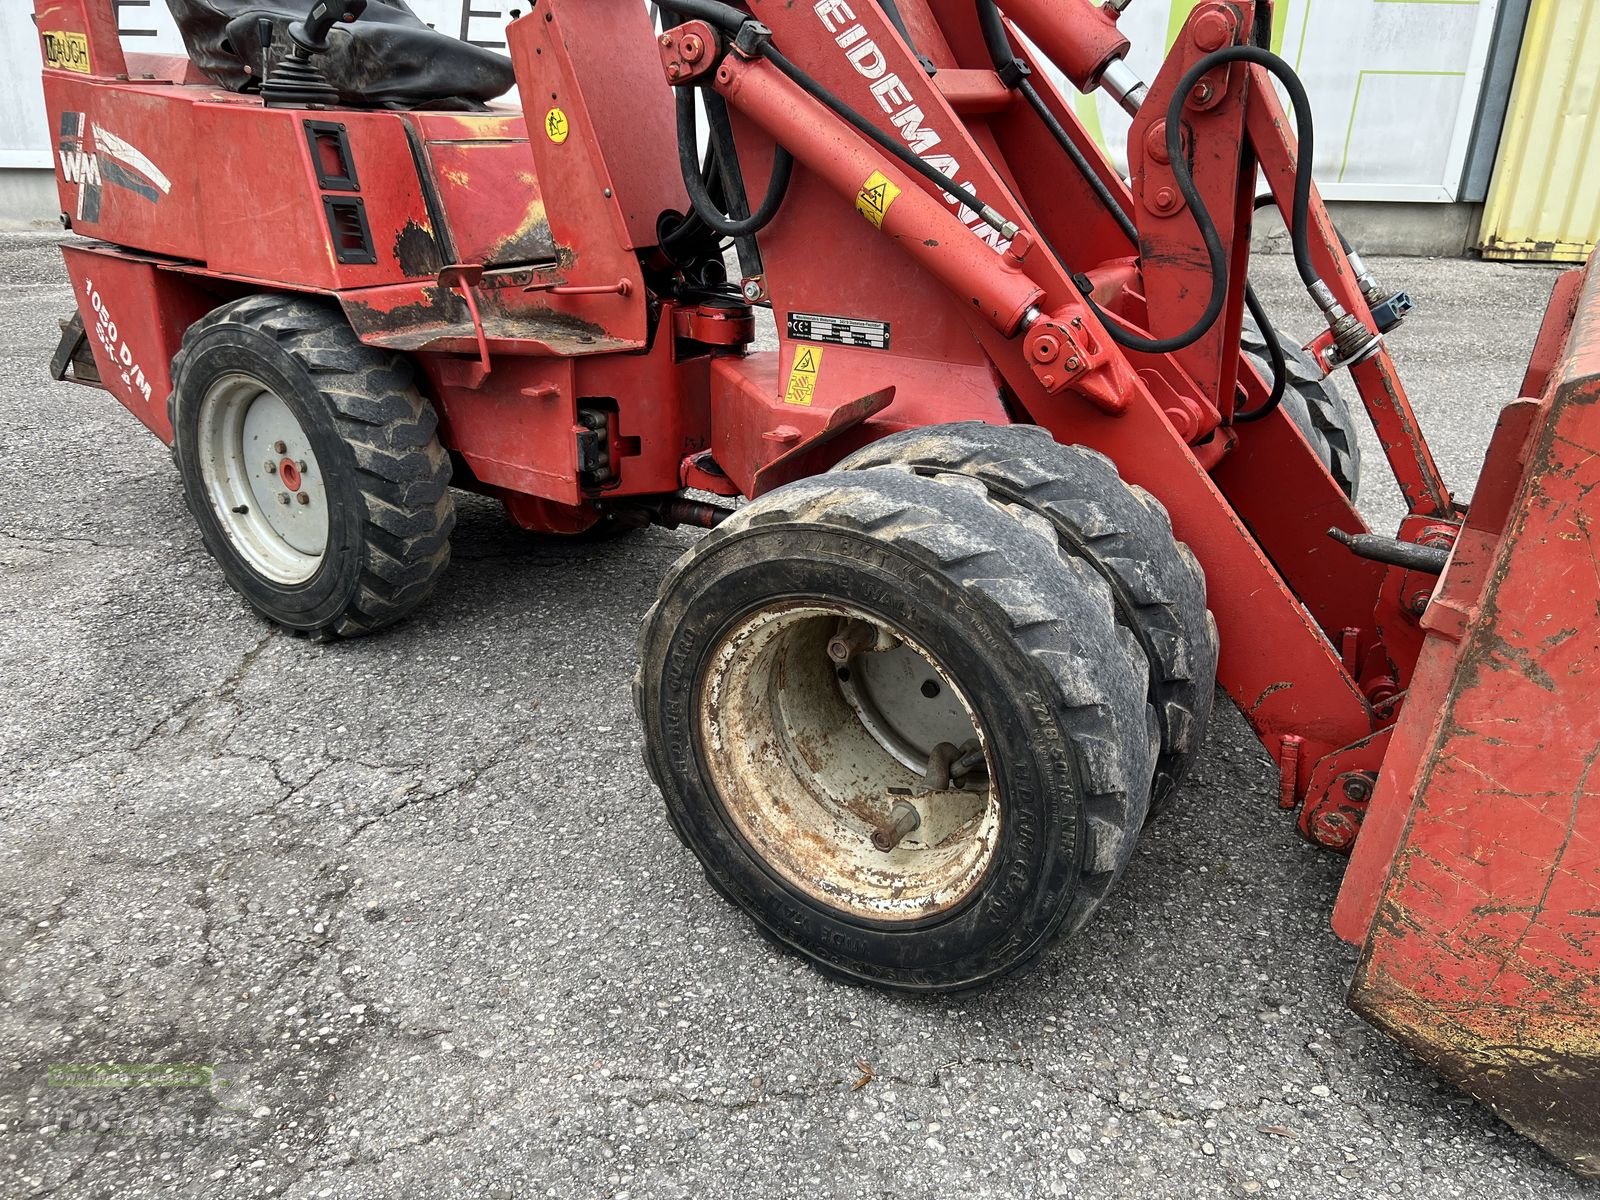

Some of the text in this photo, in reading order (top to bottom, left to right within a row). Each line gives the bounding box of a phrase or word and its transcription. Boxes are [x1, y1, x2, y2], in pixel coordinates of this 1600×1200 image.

[59, 149, 102, 186] WM
[86, 277, 117, 342] 1050
[119, 341, 152, 402] D/M
